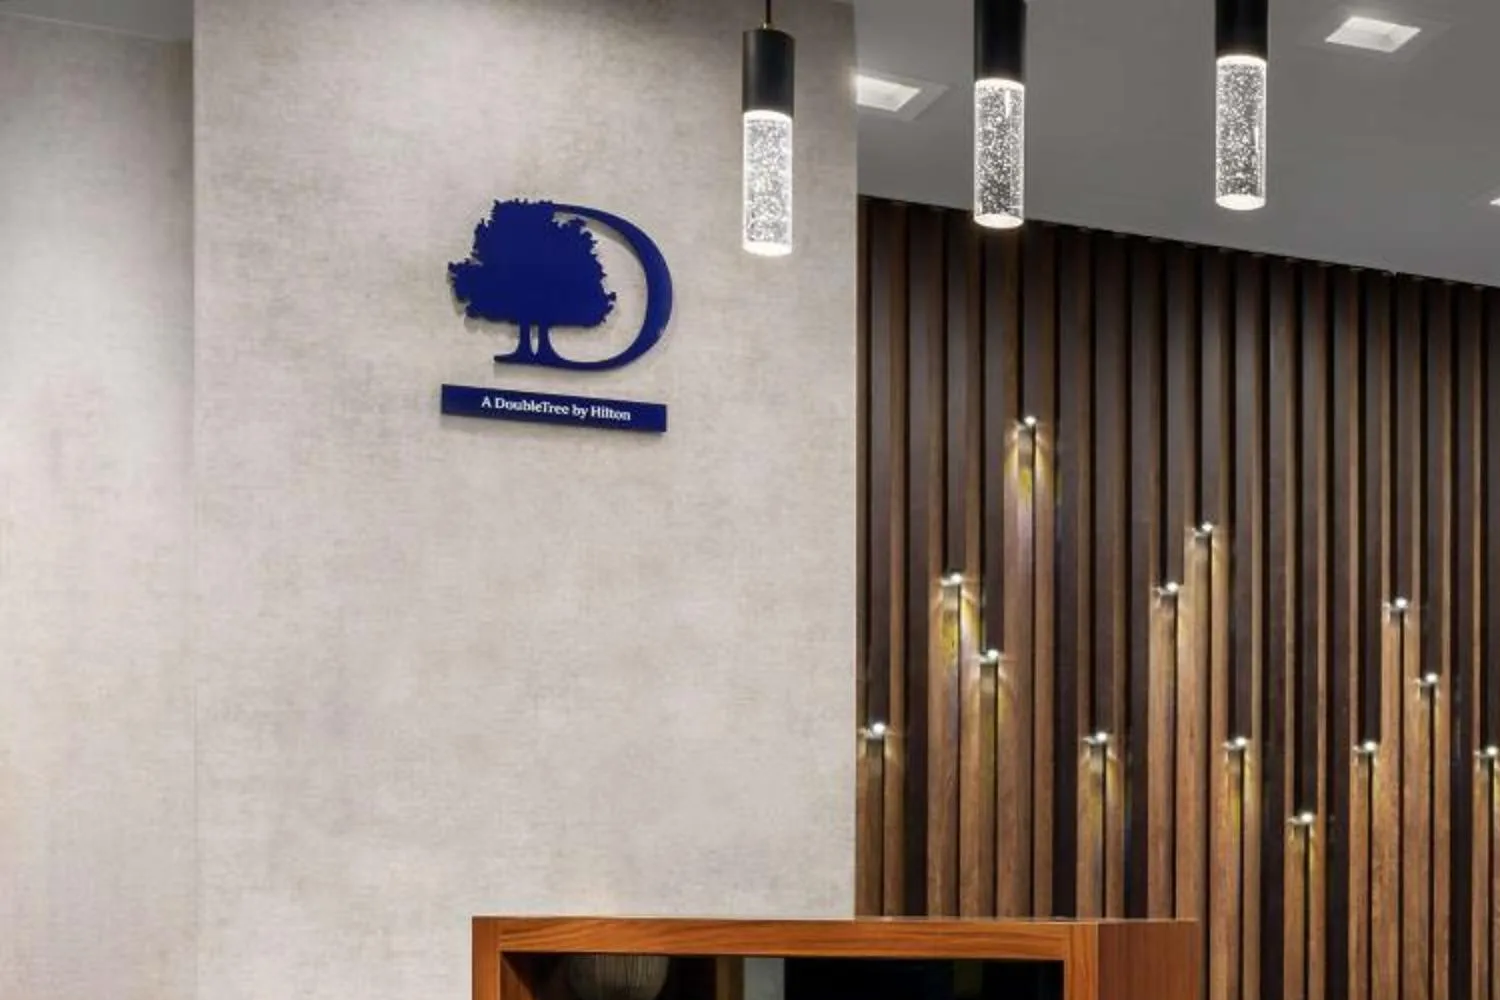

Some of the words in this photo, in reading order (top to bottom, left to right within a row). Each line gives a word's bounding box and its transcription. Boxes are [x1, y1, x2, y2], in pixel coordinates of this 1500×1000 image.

[481, 396, 492, 408] A
[495, 398, 570, 414] DoubleTree
[572, 404, 588, 418] by
[591, 406, 631, 421] Hilton
